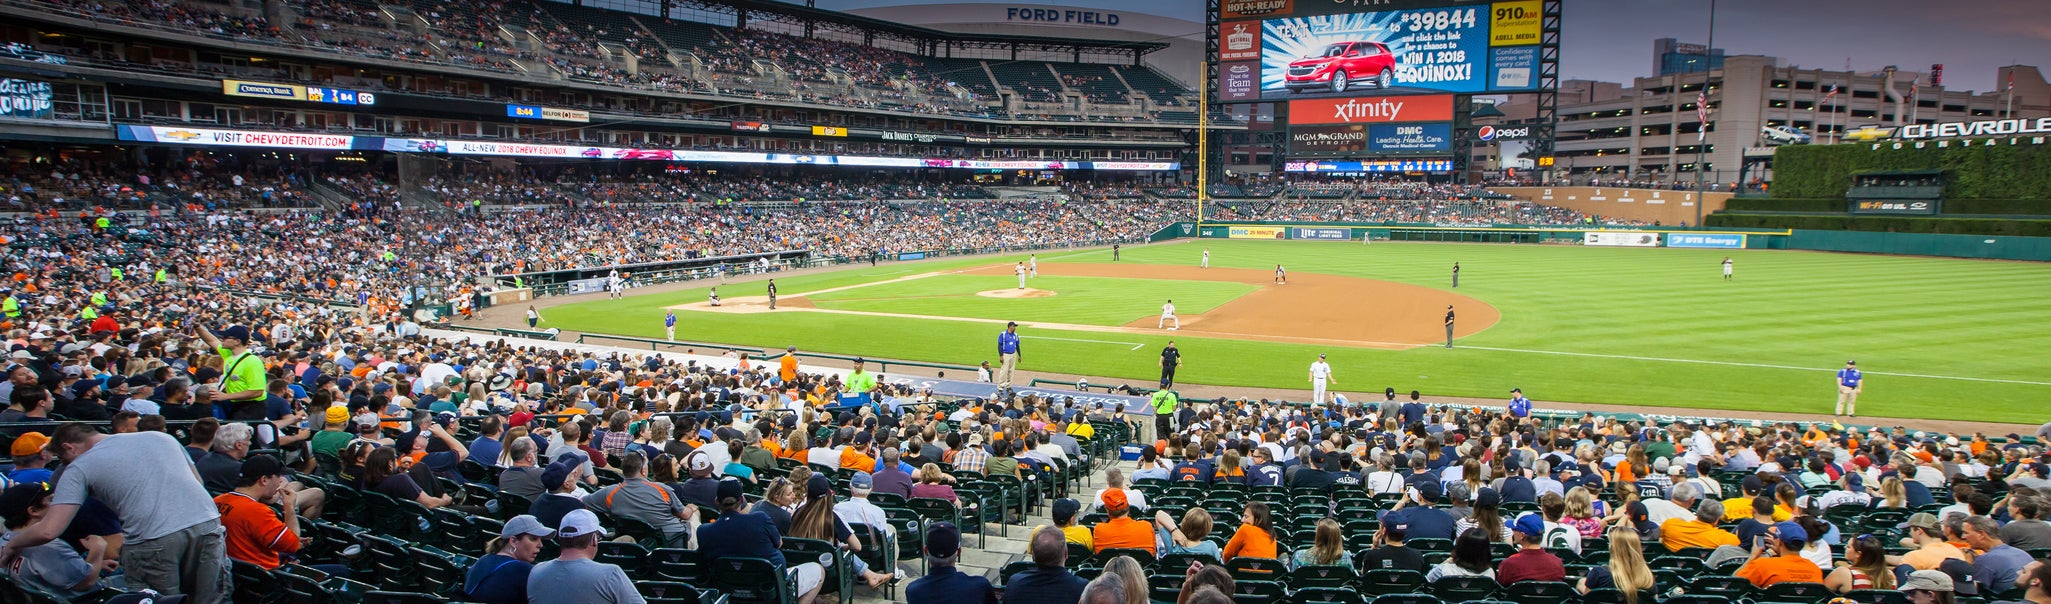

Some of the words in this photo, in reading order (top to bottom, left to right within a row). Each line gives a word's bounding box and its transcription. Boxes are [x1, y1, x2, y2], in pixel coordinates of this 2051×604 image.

[1227, 0, 1287, 12] HOT-N-READY
[1007, 8, 1059, 21] FORD
[1064, 10, 1119, 26] FIELD
[1277, 23, 1309, 38] TEXT
[1390, 22, 1400, 32] to
[1416, 32, 1432, 42] click
[1434, 32, 1446, 40] the
[1448, 31, 1461, 40] link
[1424, 42, 1447, 50] chance
[1449, 41, 1457, 49] to
[1426, 52, 1434, 64] A
[1437, 50, 1466, 64] 2018
[1228, 78, 1250, 88] Team
[516, 107, 533, 116] 8:44
[1334, 98, 1404, 122] xfinity
[882, 131, 894, 140] JACK
[1396, 126, 1423, 134] DMC
[1496, 127, 1528, 138] pepsi
[214, 132, 241, 143] VISIT
[245, 133, 346, 147] CHEVYDETROIT.COM
[1330, 132, 1364, 140] GRAND
[1872, 136, 2045, 150] FOUNTAIN
[463, 143, 496, 153] ALL-NEW
[498, 144, 514, 153] 2018
[516, 145, 538, 154] CHEVY
[540, 146, 566, 155] EQUINOX
[1269, 473, 1278, 486] 7
